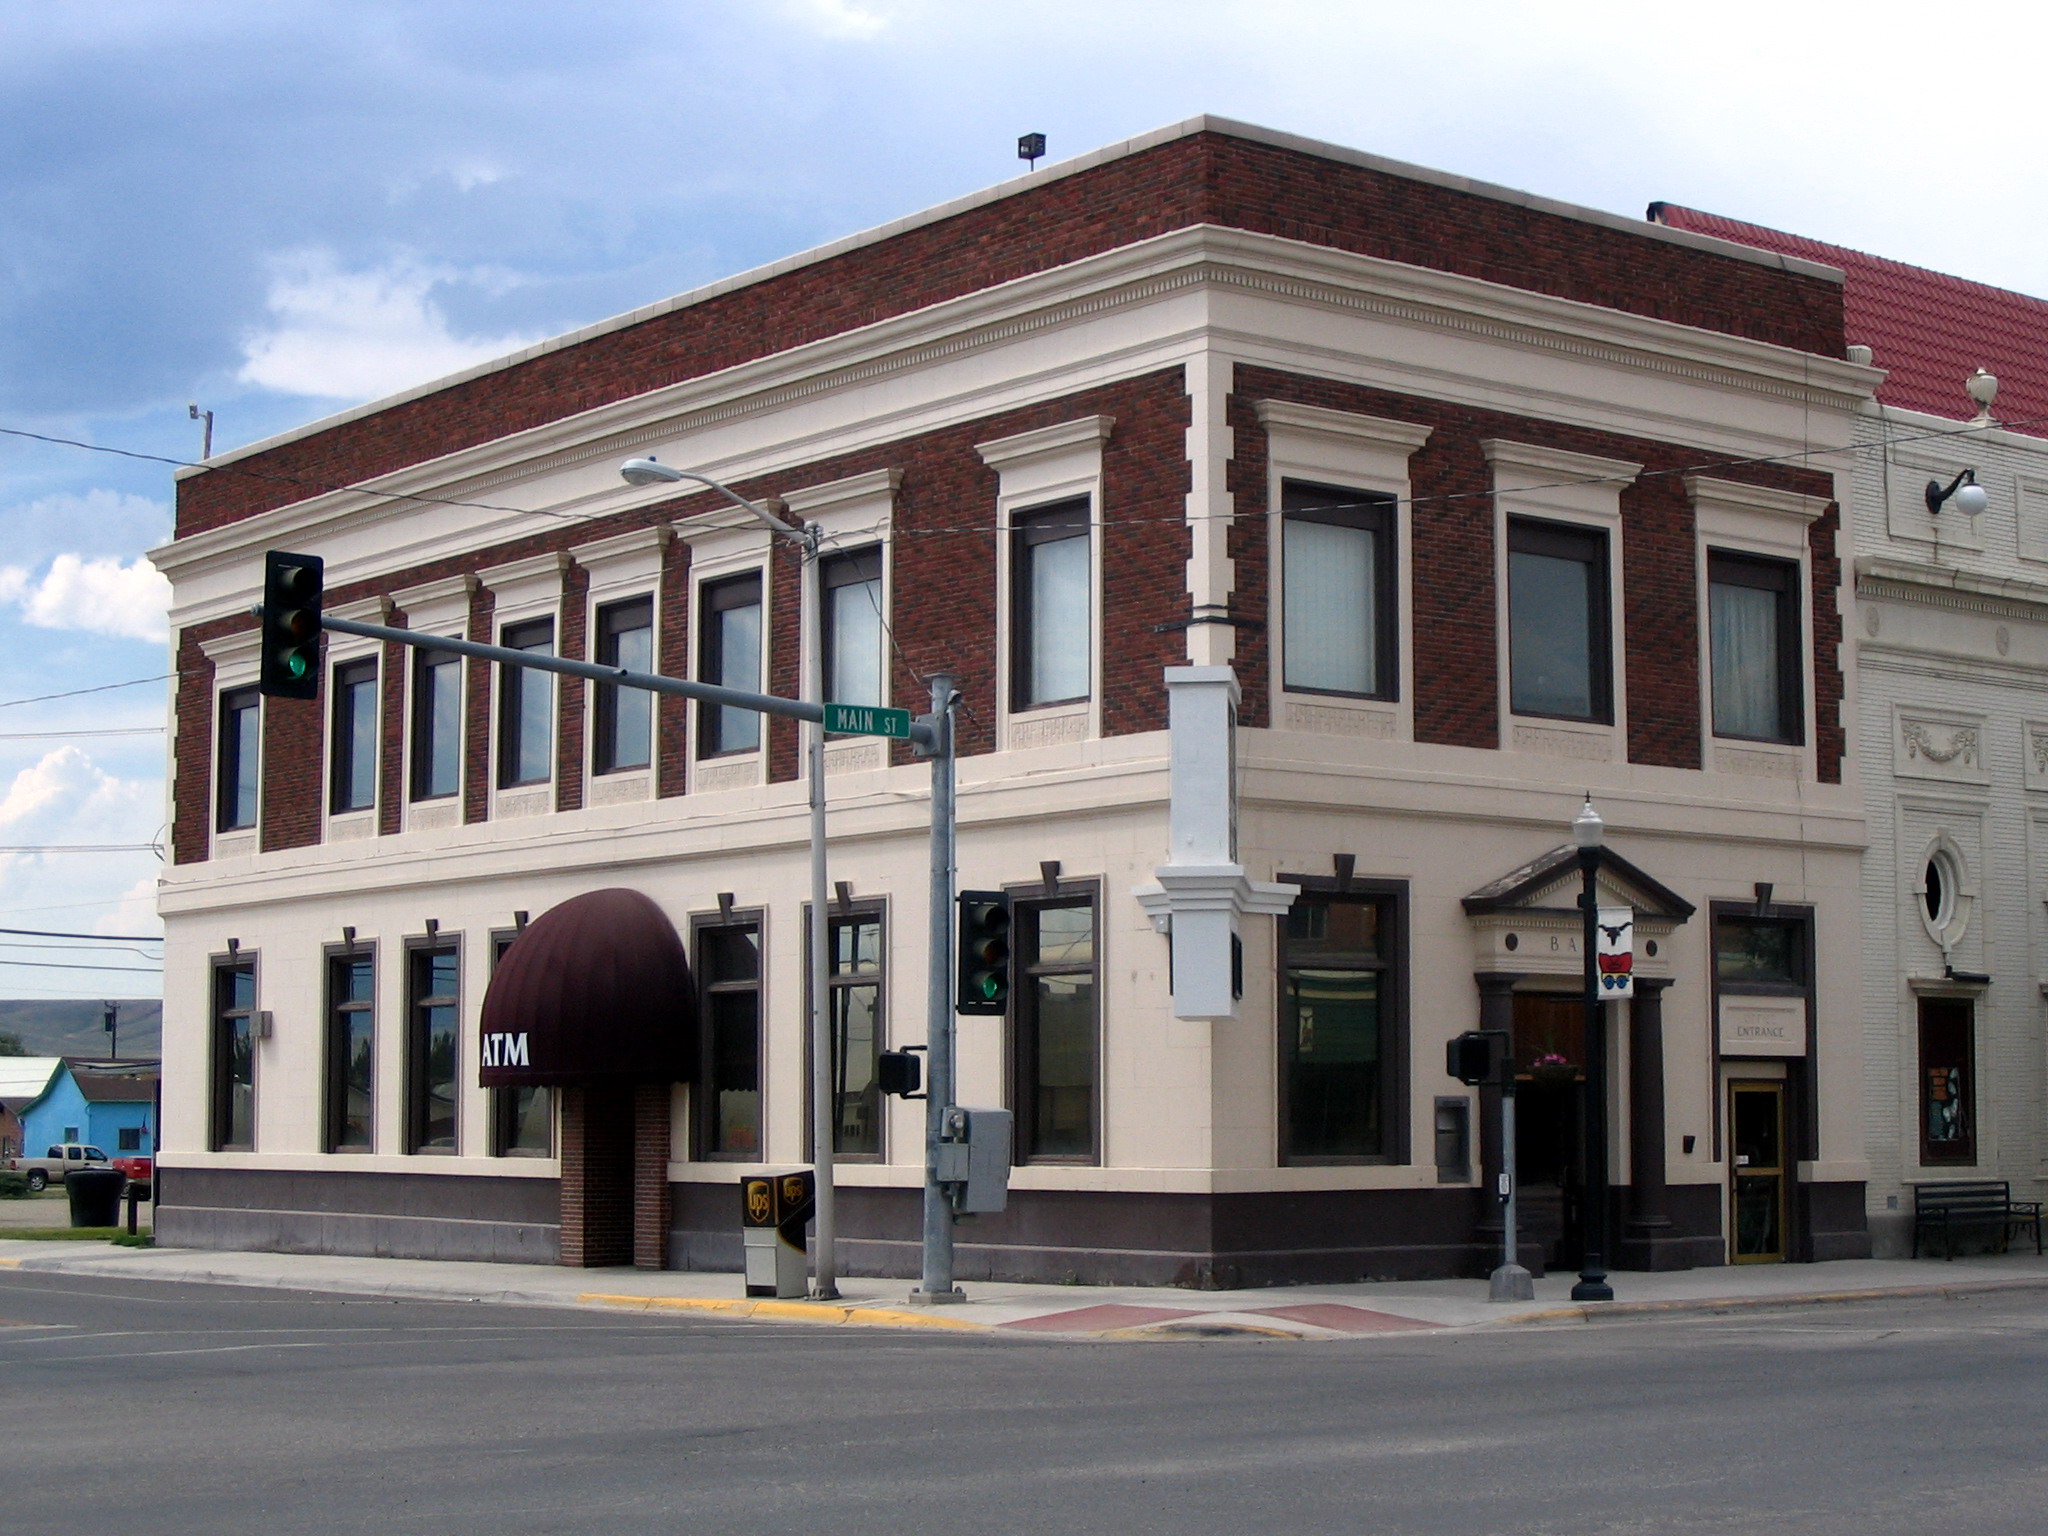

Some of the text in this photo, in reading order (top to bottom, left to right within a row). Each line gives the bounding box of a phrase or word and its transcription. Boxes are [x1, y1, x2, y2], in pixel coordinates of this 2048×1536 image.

[837, 708, 897, 734] MAIN ST
[1551, 936, 1577, 951] BA
[1737, 1026, 1784, 1037] ENTRANCE
[481, 1032, 530, 1067] ATM
